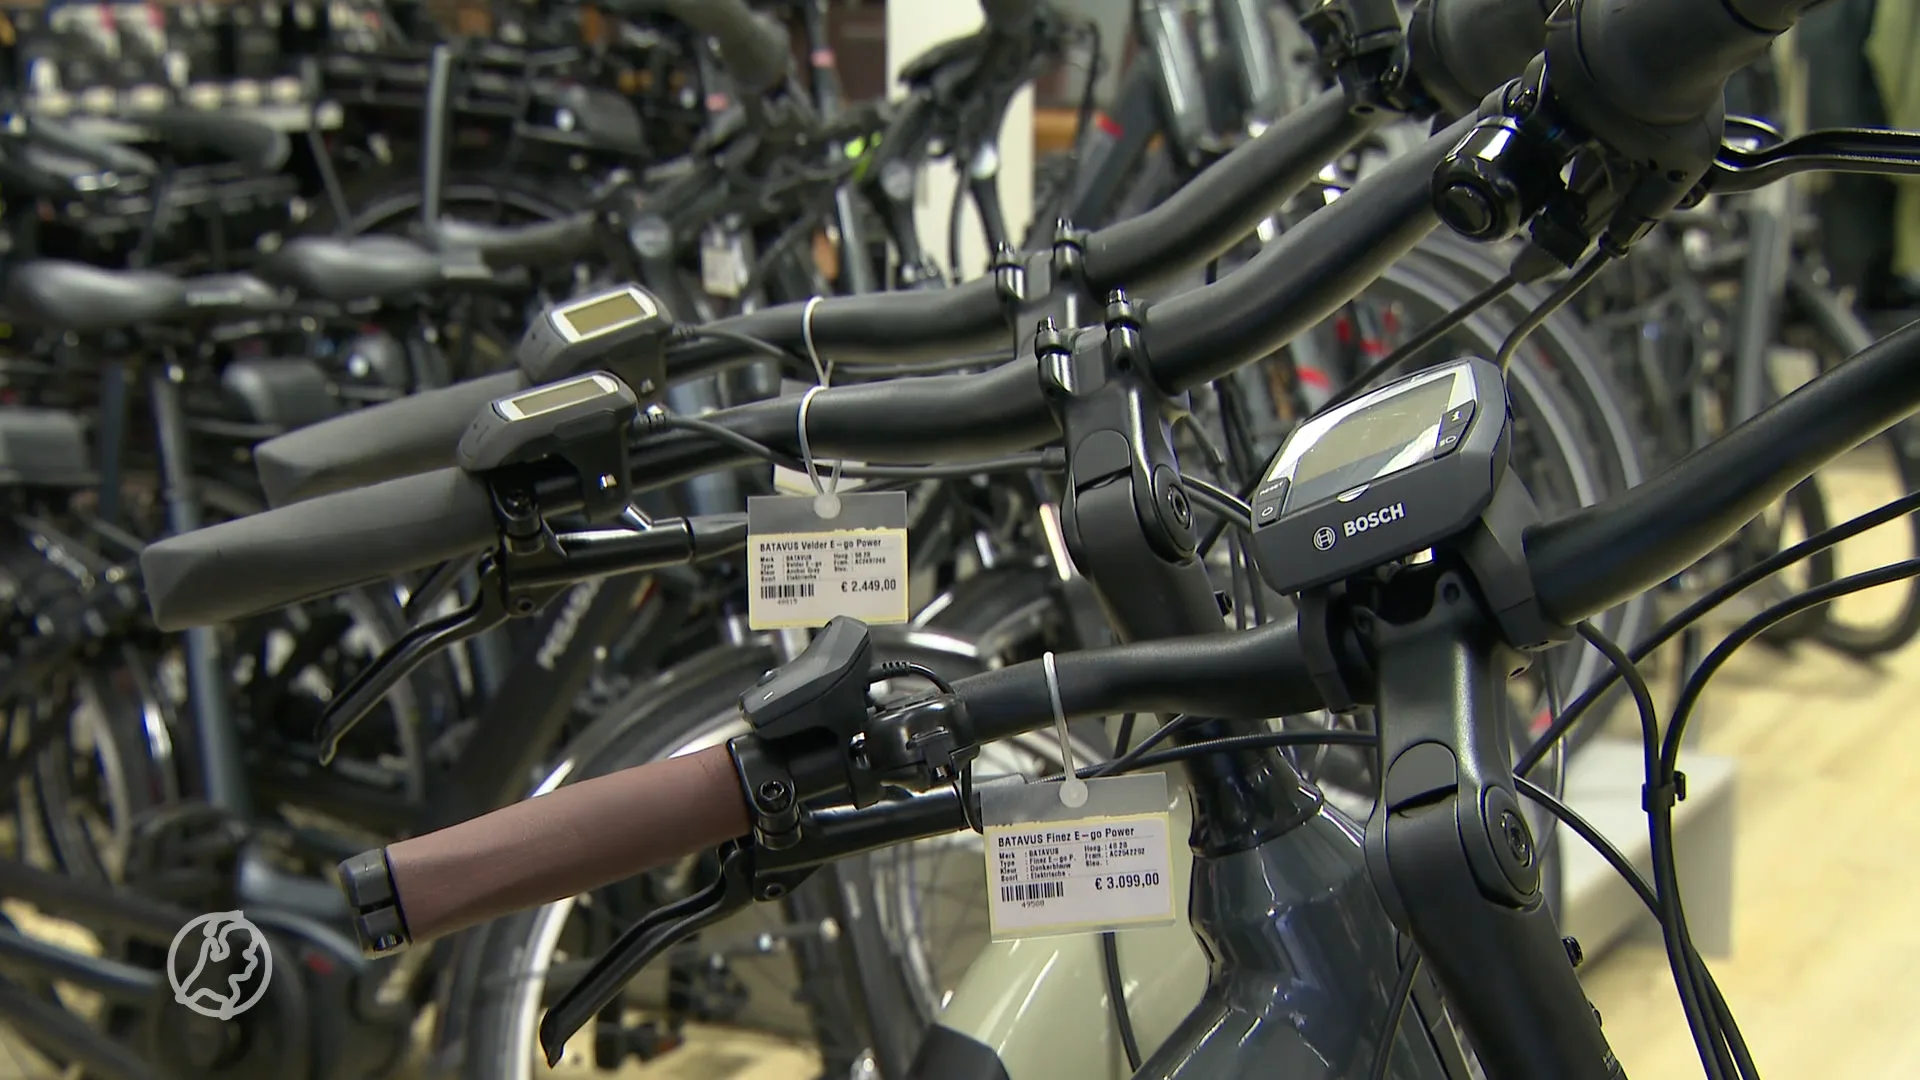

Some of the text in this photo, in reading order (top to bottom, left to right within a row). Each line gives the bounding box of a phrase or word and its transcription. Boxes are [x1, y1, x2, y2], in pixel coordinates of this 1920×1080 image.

[1343, 502, 1405, 538] BOSCH
[760, 543, 799, 553] BATAVUS
[801, 541, 828, 550] Velder
[856, 539, 881, 549] Power
[841, 579, 897, 593] € 2.449,00
[998, 834, 1043, 848] BATAVUS
[1046, 832, 1071, 844] Finez
[1105, 827, 1135, 838] Power
[999, 847, 1059, 860] Merk BATAVUS
[1000, 860, 1015, 869] Type
[1095, 872, 1160, 890] € 3.099,00
